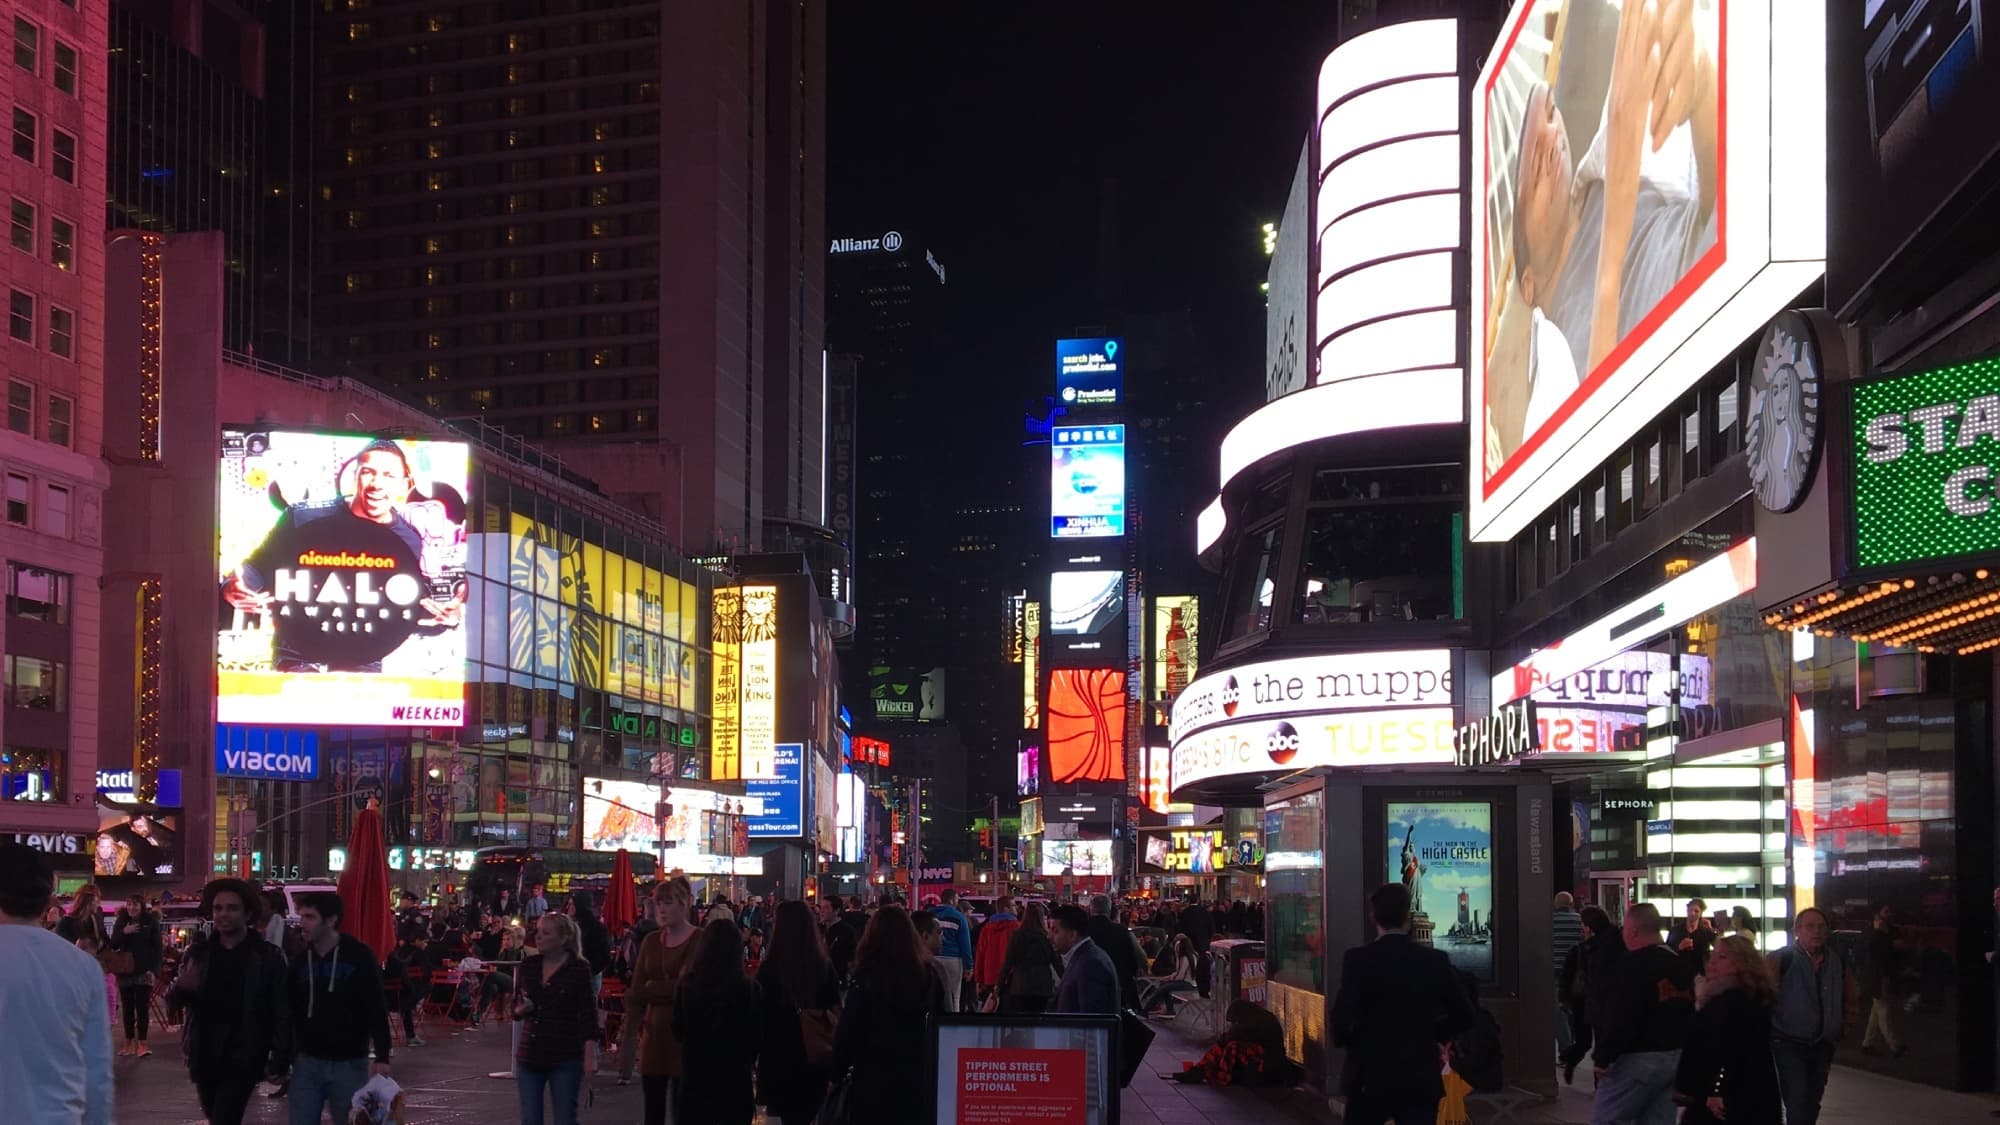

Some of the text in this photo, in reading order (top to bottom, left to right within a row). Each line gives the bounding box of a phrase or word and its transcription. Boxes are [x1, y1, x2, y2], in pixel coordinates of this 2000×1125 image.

[830, 238, 880, 253] Allianz
[1944, 465, 2000, 516] C
[1067, 517, 1109, 528] XINHUA
[299, 551, 395, 569] nickelodeon
[279, 605, 412, 620] AWARDS
[1013, 589, 1027, 663] NOVOTEL
[1253, 673, 1304, 704] the
[745, 691, 772, 704] KING
[392, 706, 461, 721] WEEKEND
[1266, 731, 1300, 751] abc
[1453, 700, 1531, 767] SEPHORA
[1604, 800, 1654, 809] SEPHORA
[1422, 847, 1488, 860] HIGH CASTLE
[924, 867, 953, 880] NYC
[965, 1061, 1048, 1071] TIPPING STREET
[965, 1072, 1050, 1082] PERFORMERS IS
[965, 1082, 1017, 1092] OPTIONAL
